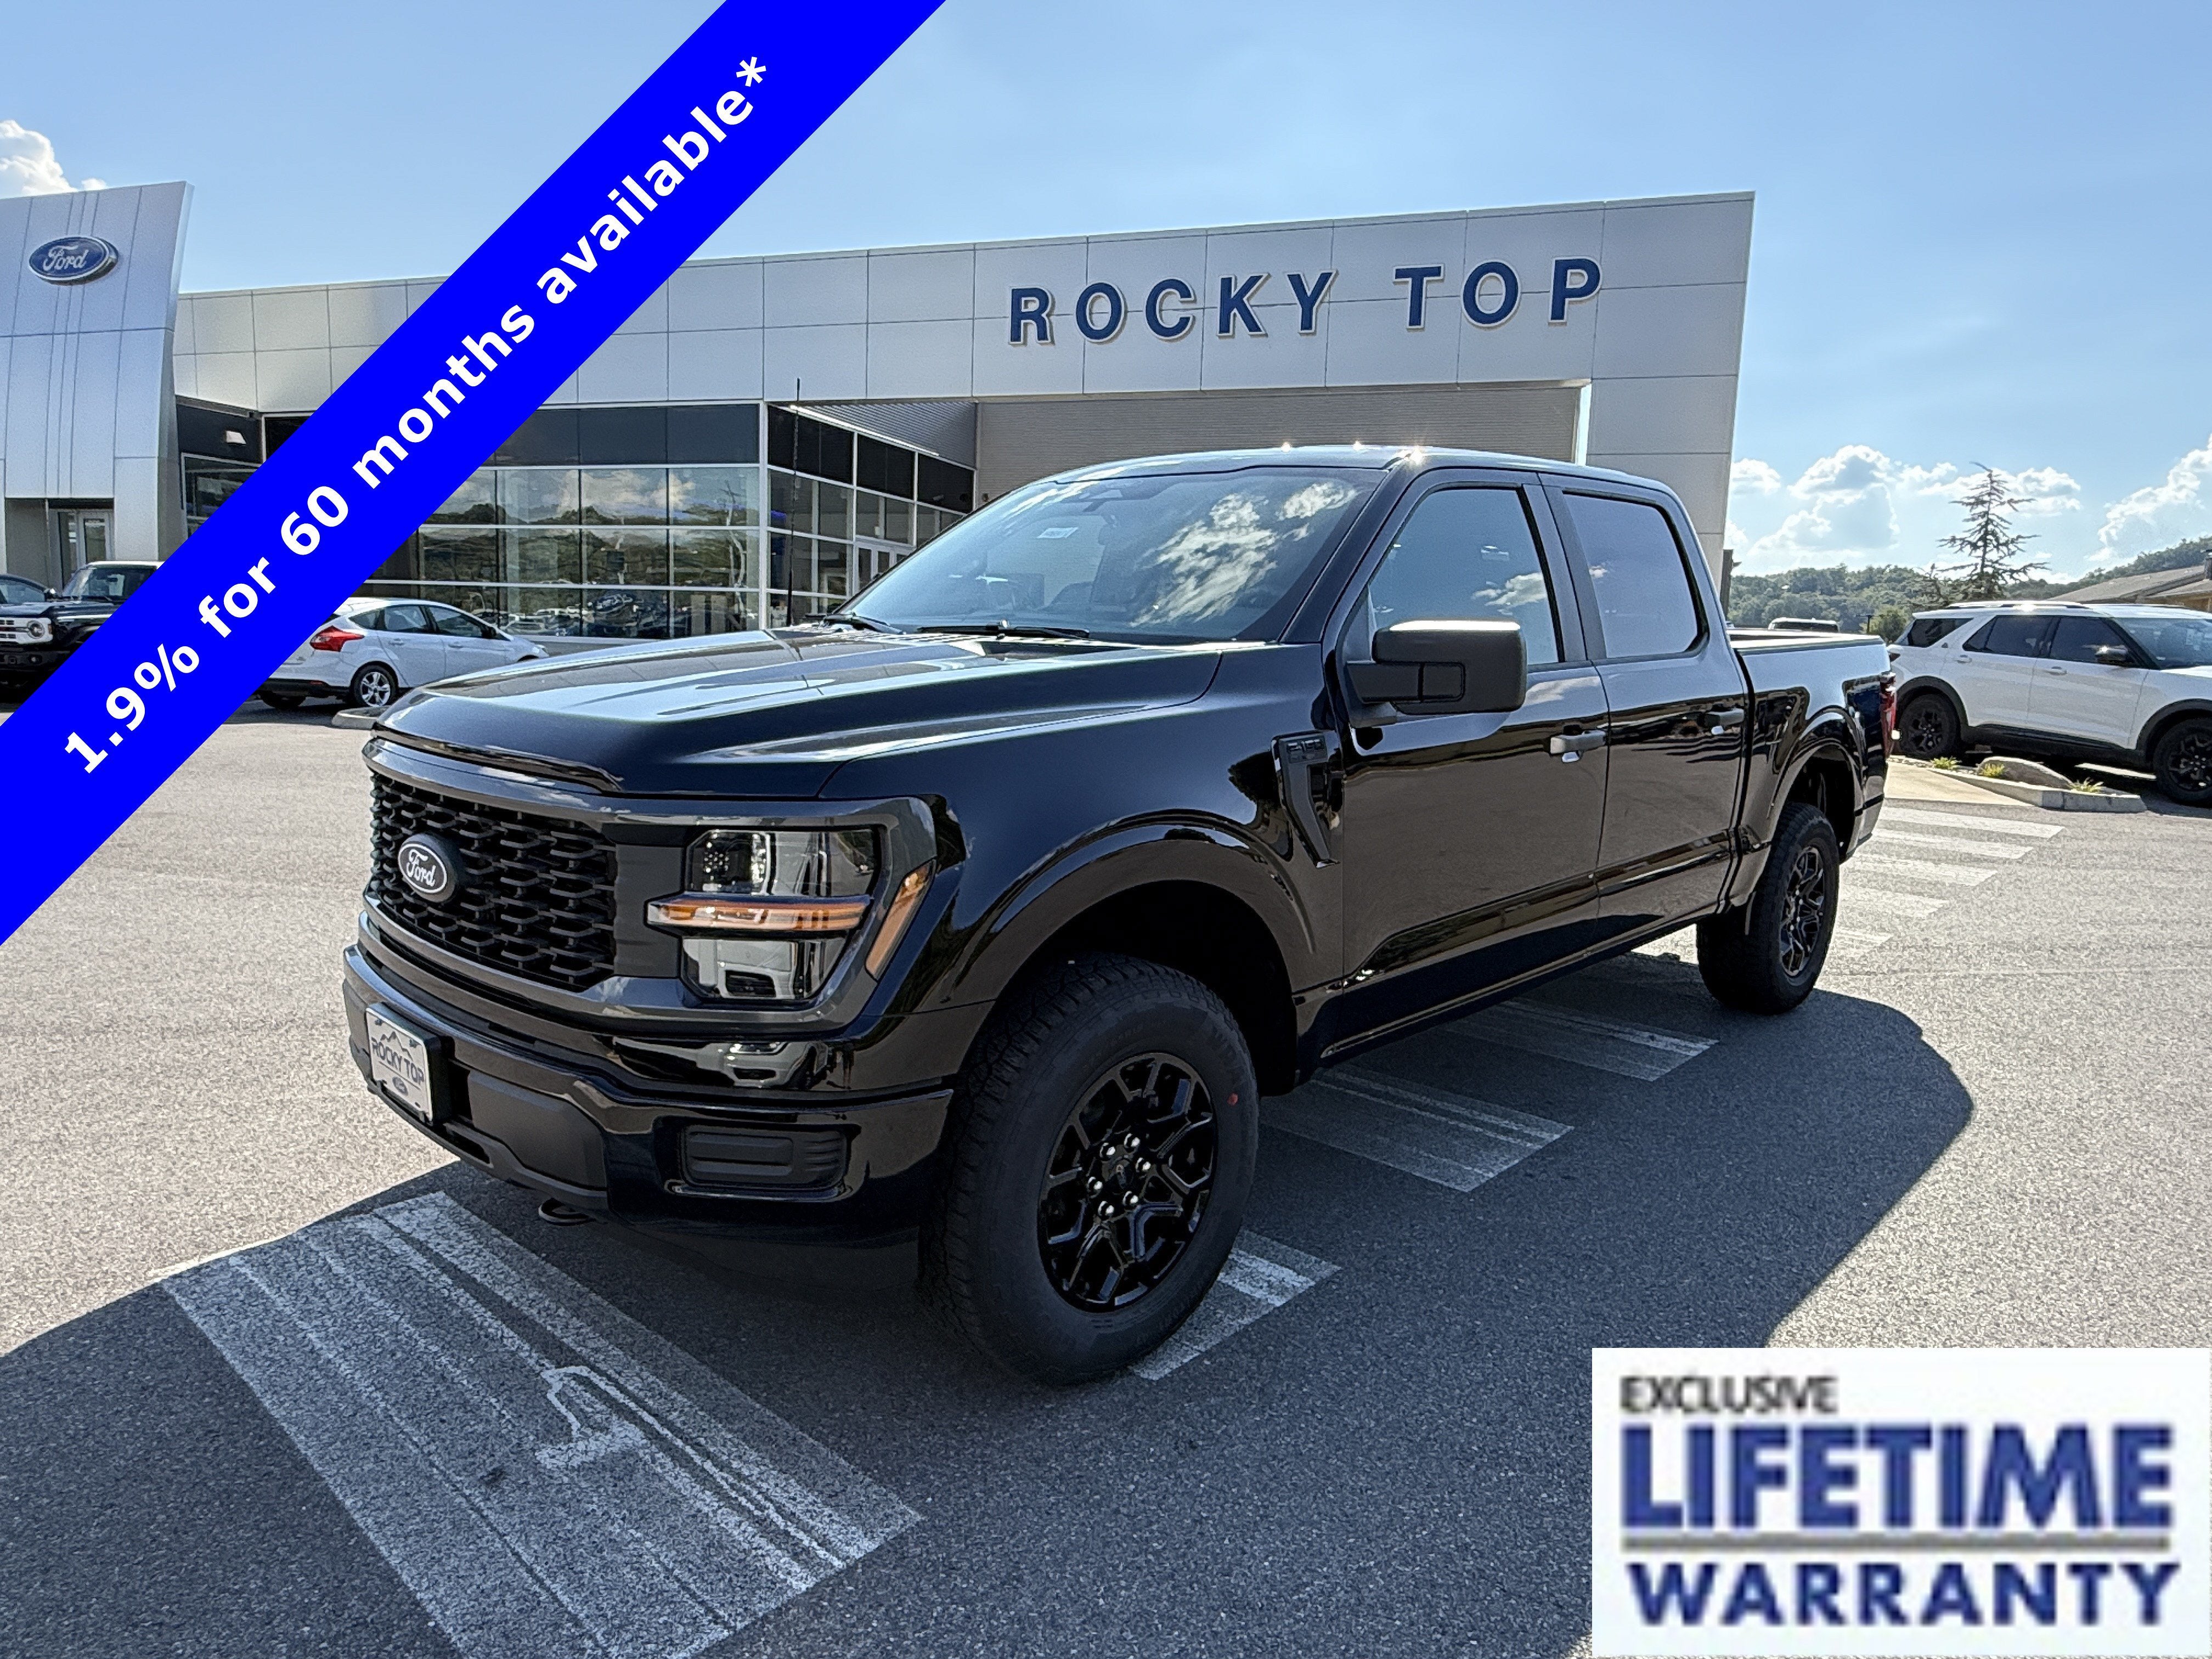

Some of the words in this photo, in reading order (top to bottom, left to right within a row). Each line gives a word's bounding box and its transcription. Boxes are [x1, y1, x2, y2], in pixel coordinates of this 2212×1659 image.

[43, 245, 89, 272] Ford
[1008, 268, 1338, 346] ROCKY
[1393, 257, 1603, 328] TOP
[406, 849, 436, 887] Ford
[370, 1036, 403, 1073] ROCKY
[404, 1058, 425, 1084] TOP
